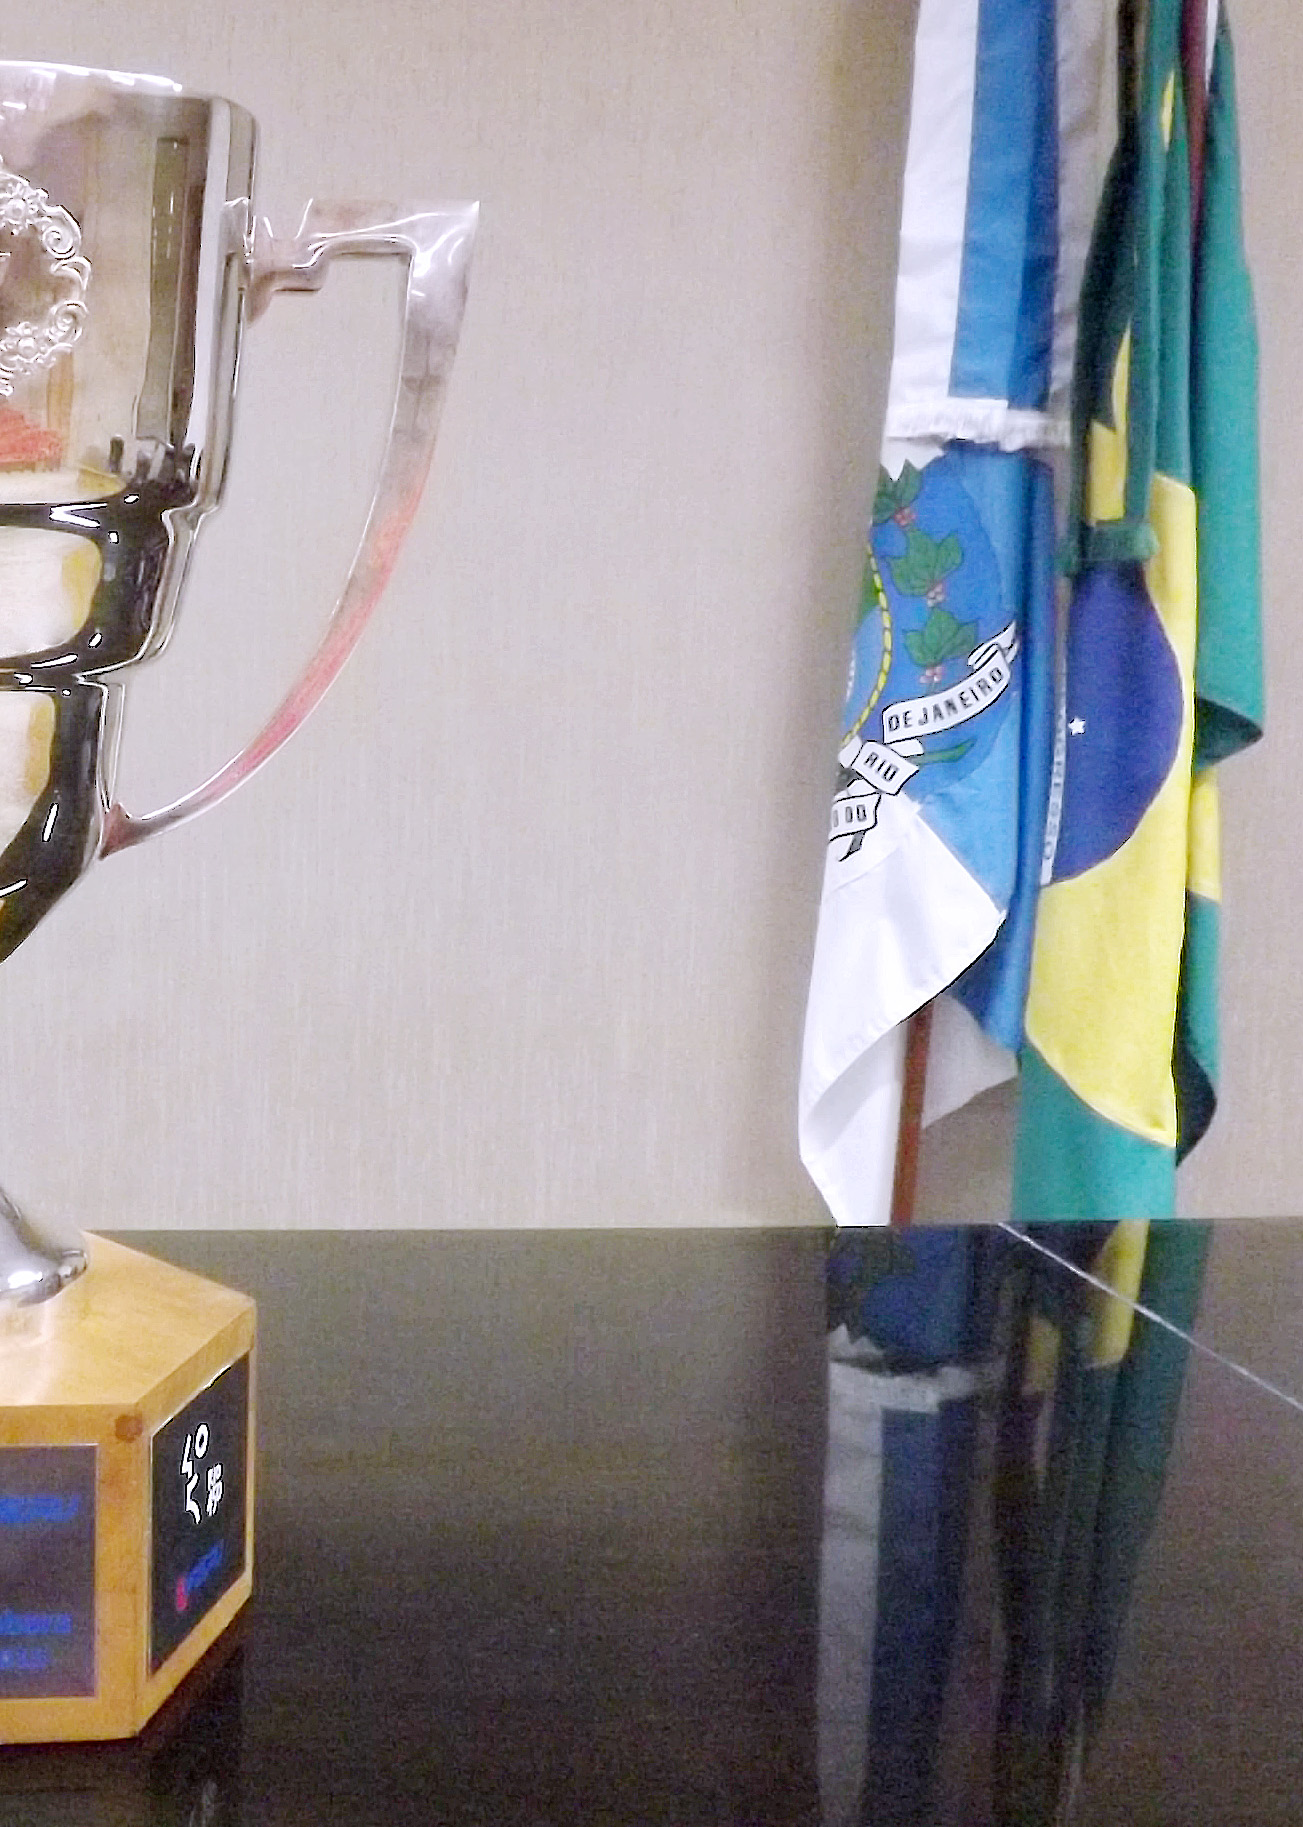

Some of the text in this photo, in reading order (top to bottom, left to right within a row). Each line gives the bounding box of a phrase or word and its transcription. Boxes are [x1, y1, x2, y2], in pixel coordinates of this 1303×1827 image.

[888, 666, 1004, 732] DE JANEIRO
[863, 751, 900, 783] RIO
